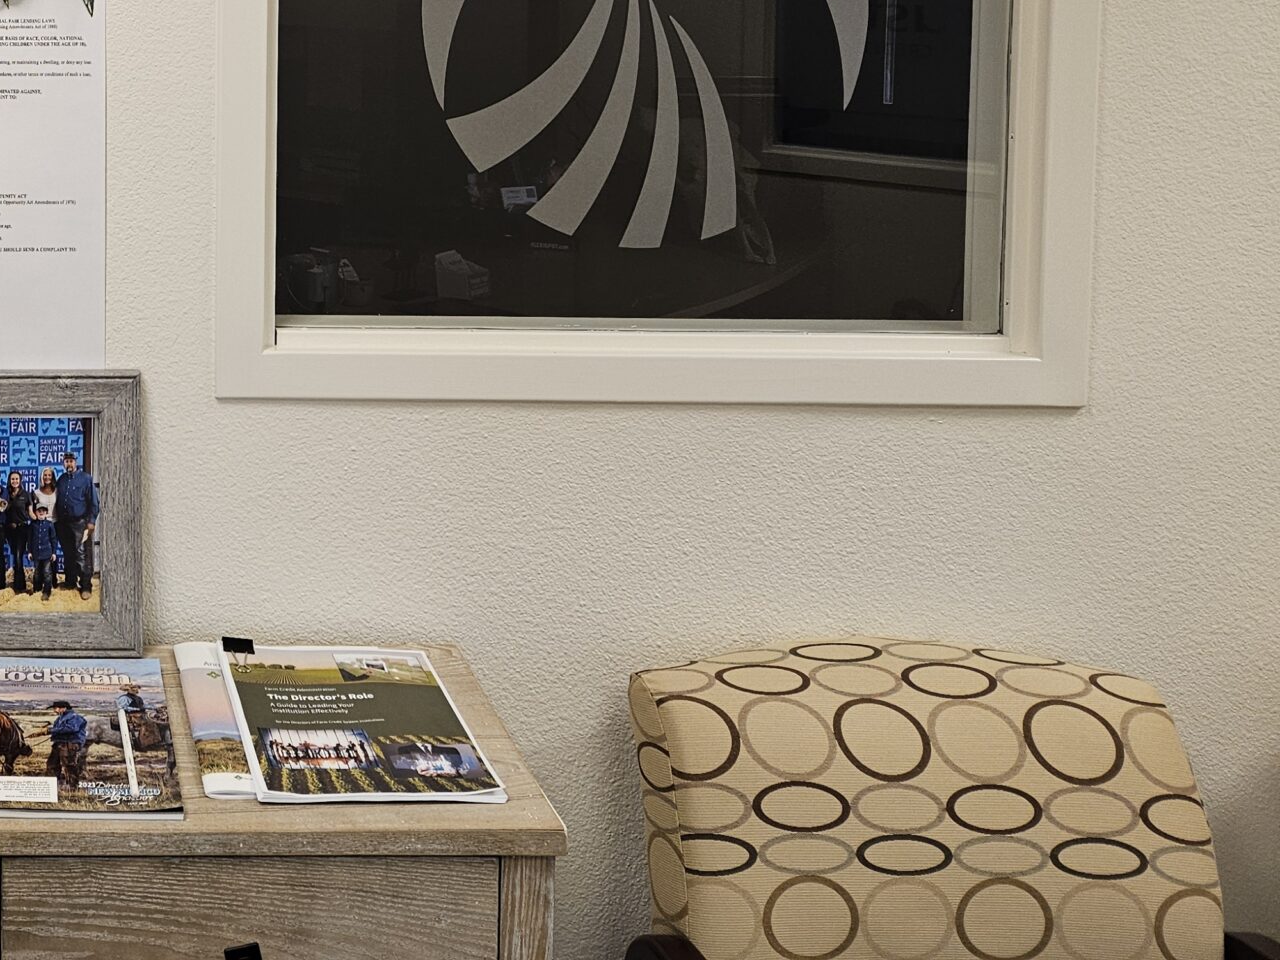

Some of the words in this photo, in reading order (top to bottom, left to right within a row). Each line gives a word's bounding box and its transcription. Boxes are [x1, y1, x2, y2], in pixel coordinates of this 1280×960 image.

[11, 422, 36, 433] FAIR
[70, 422, 82, 431] FA
[96, 781, 130, 789] Director
